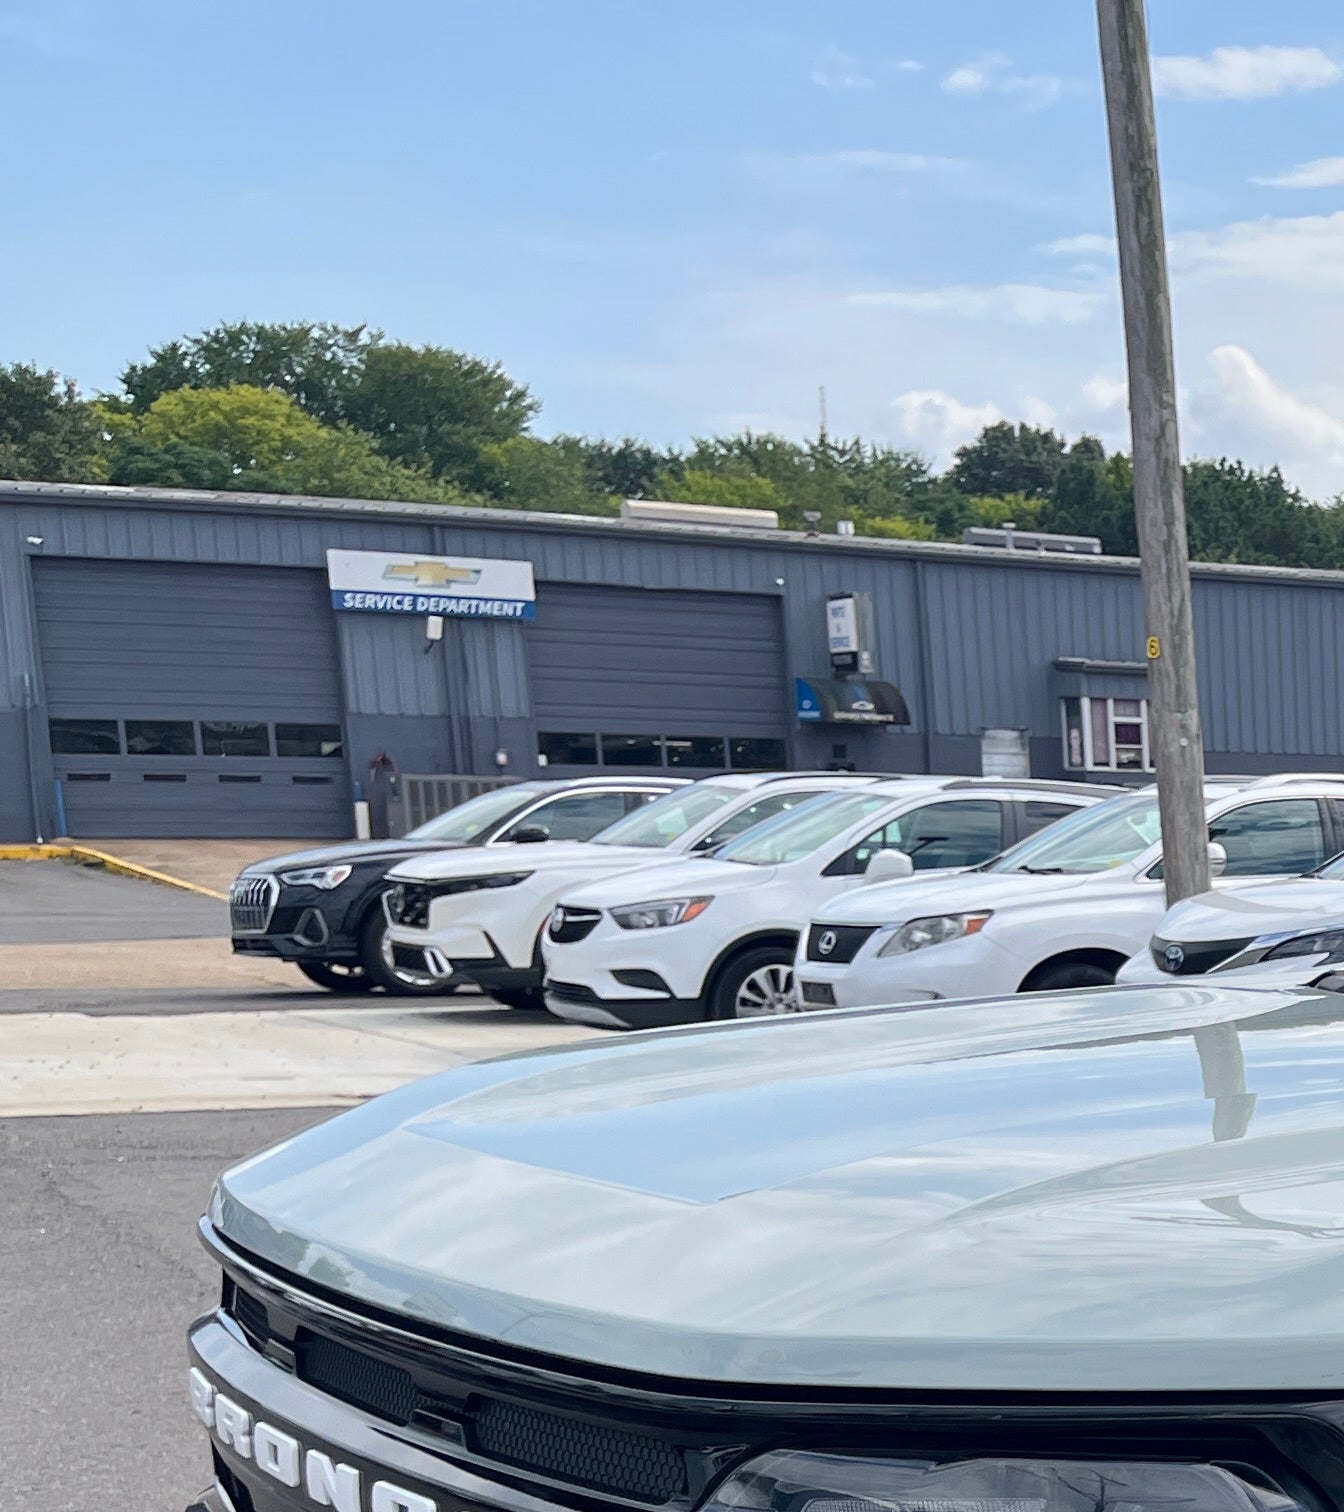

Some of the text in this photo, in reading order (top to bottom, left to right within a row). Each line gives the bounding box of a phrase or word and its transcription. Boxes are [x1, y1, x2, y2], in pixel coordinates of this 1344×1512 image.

[343, 592, 526, 617] SERVICE DEPARTMENT
[1149, 639, 1158, 656] 6
